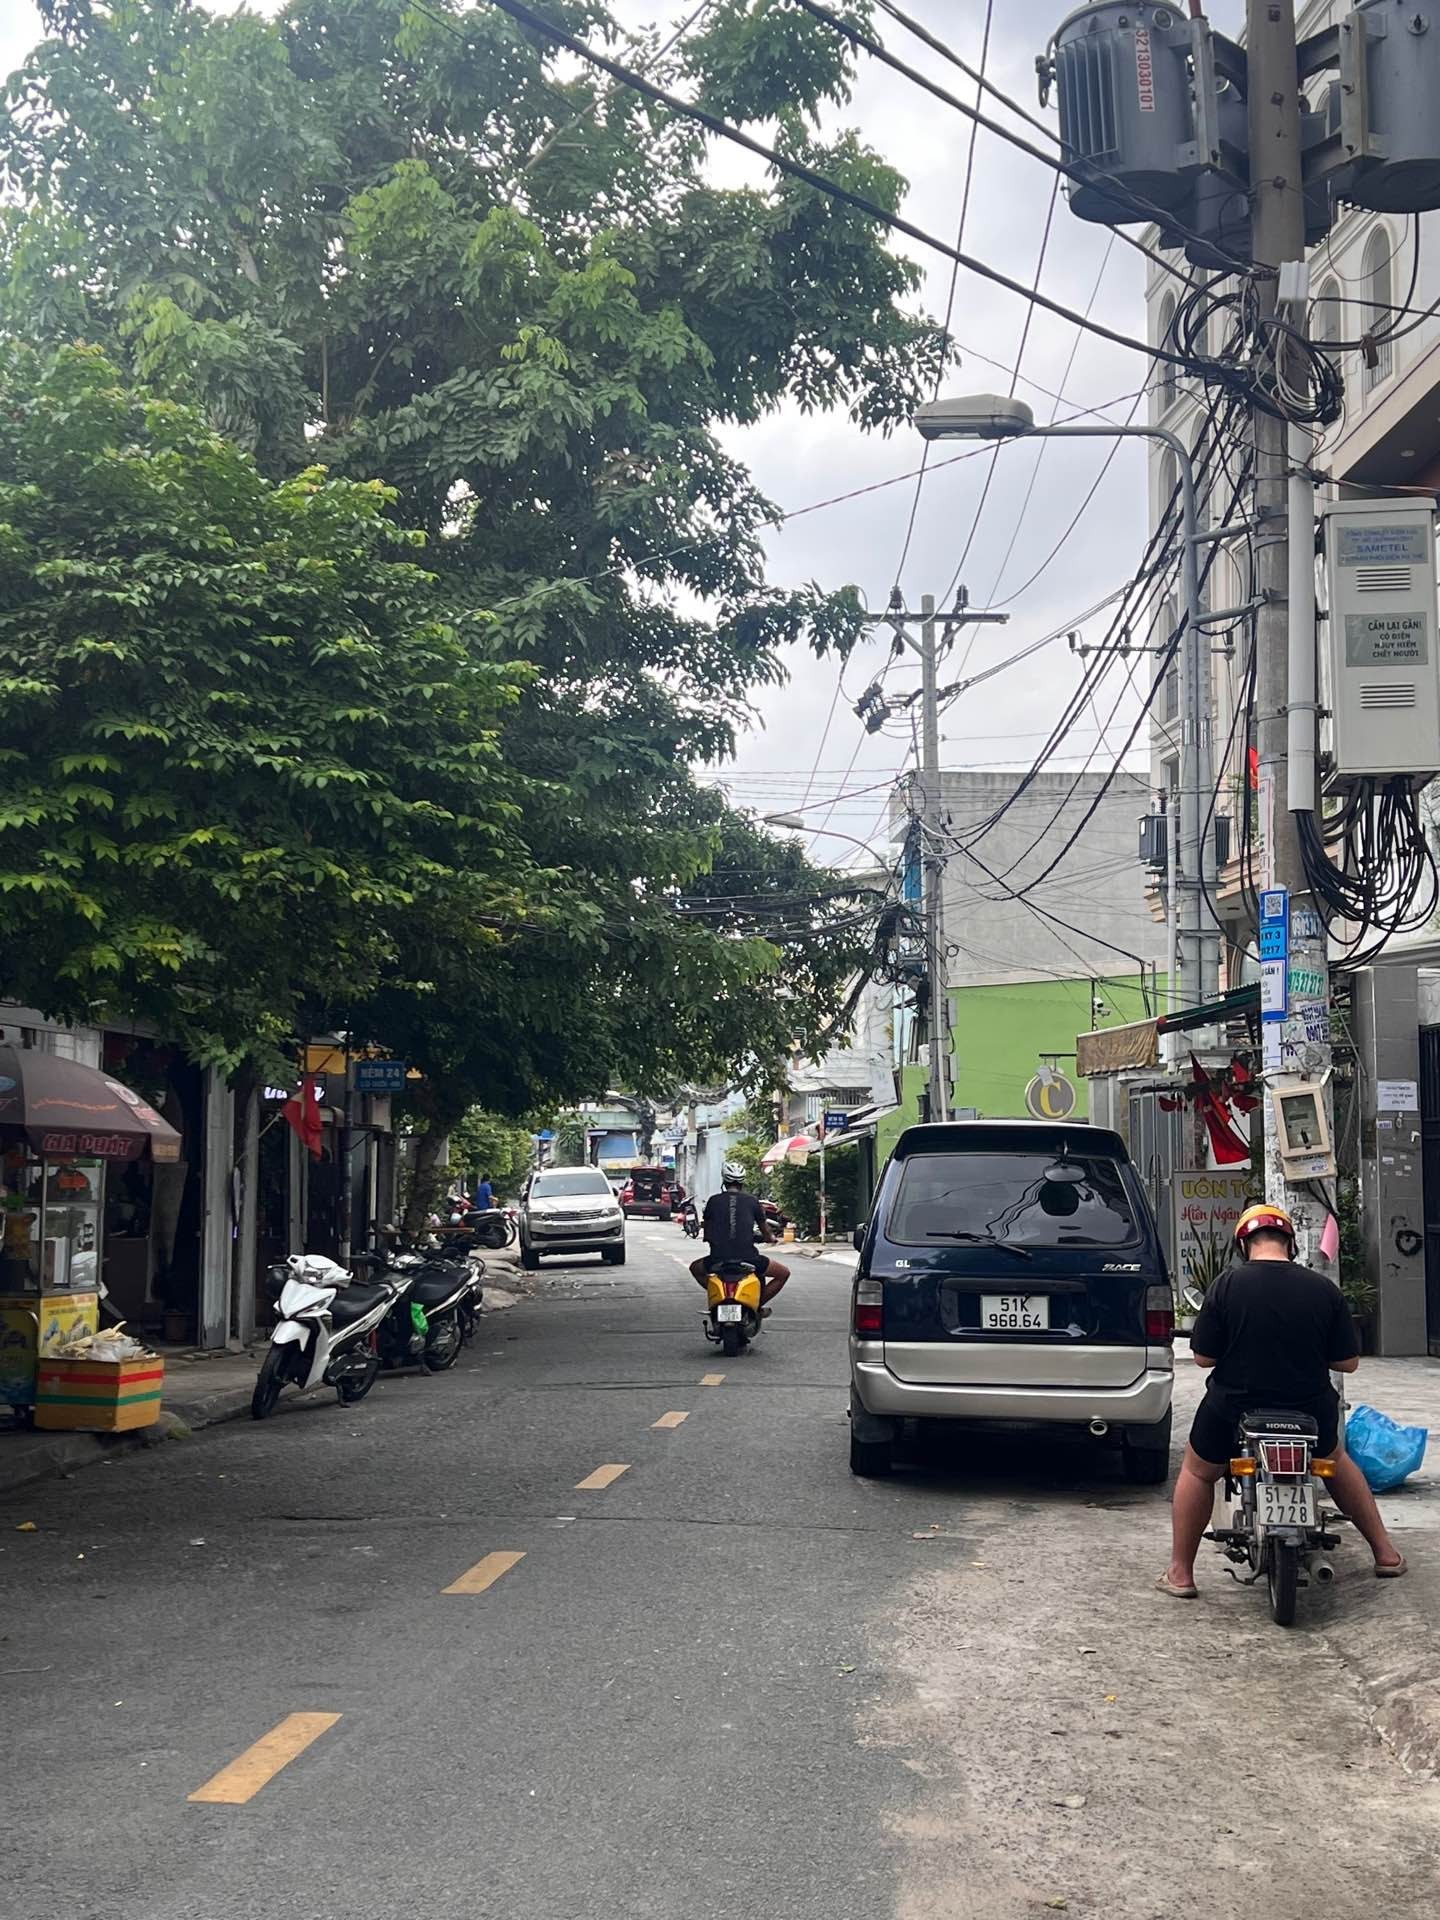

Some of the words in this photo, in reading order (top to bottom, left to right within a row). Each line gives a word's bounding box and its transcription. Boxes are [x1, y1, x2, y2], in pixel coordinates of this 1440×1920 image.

[1135, 31, 1154, 110] 3213030101
[1357, 544, 1409, 554] SAMETEL
[386, 1068, 400, 1078] 24
[896, 1260, 910, 1268] GL
[1001, 1298, 1029, 1312] 51K
[988, 1314, 1041, 1328] 968.64
[1266, 1506, 1308, 1523] 2728
